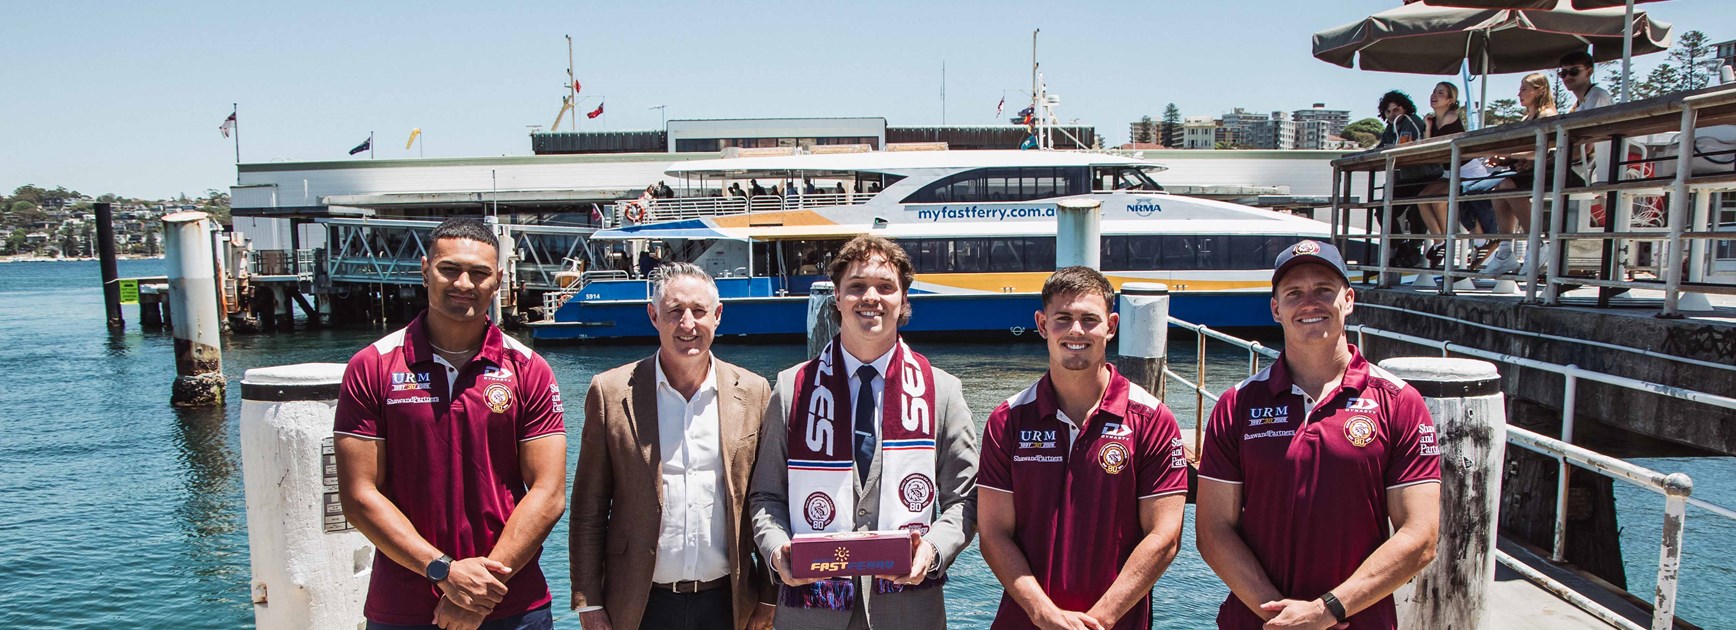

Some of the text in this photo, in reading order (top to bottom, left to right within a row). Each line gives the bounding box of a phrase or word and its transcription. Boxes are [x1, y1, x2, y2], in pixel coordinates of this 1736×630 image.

[1126, 204, 1162, 212] NRMA
[918, 206, 1057, 222] myfastferry.com.a
[392, 372, 430, 384] URM
[1250, 406, 1288, 418] URM
[1020, 430, 1056, 442] URM
[1420, 434, 1434, 443] and
[909, 502, 922, 511] 80
[812, 520, 824, 530] 80
